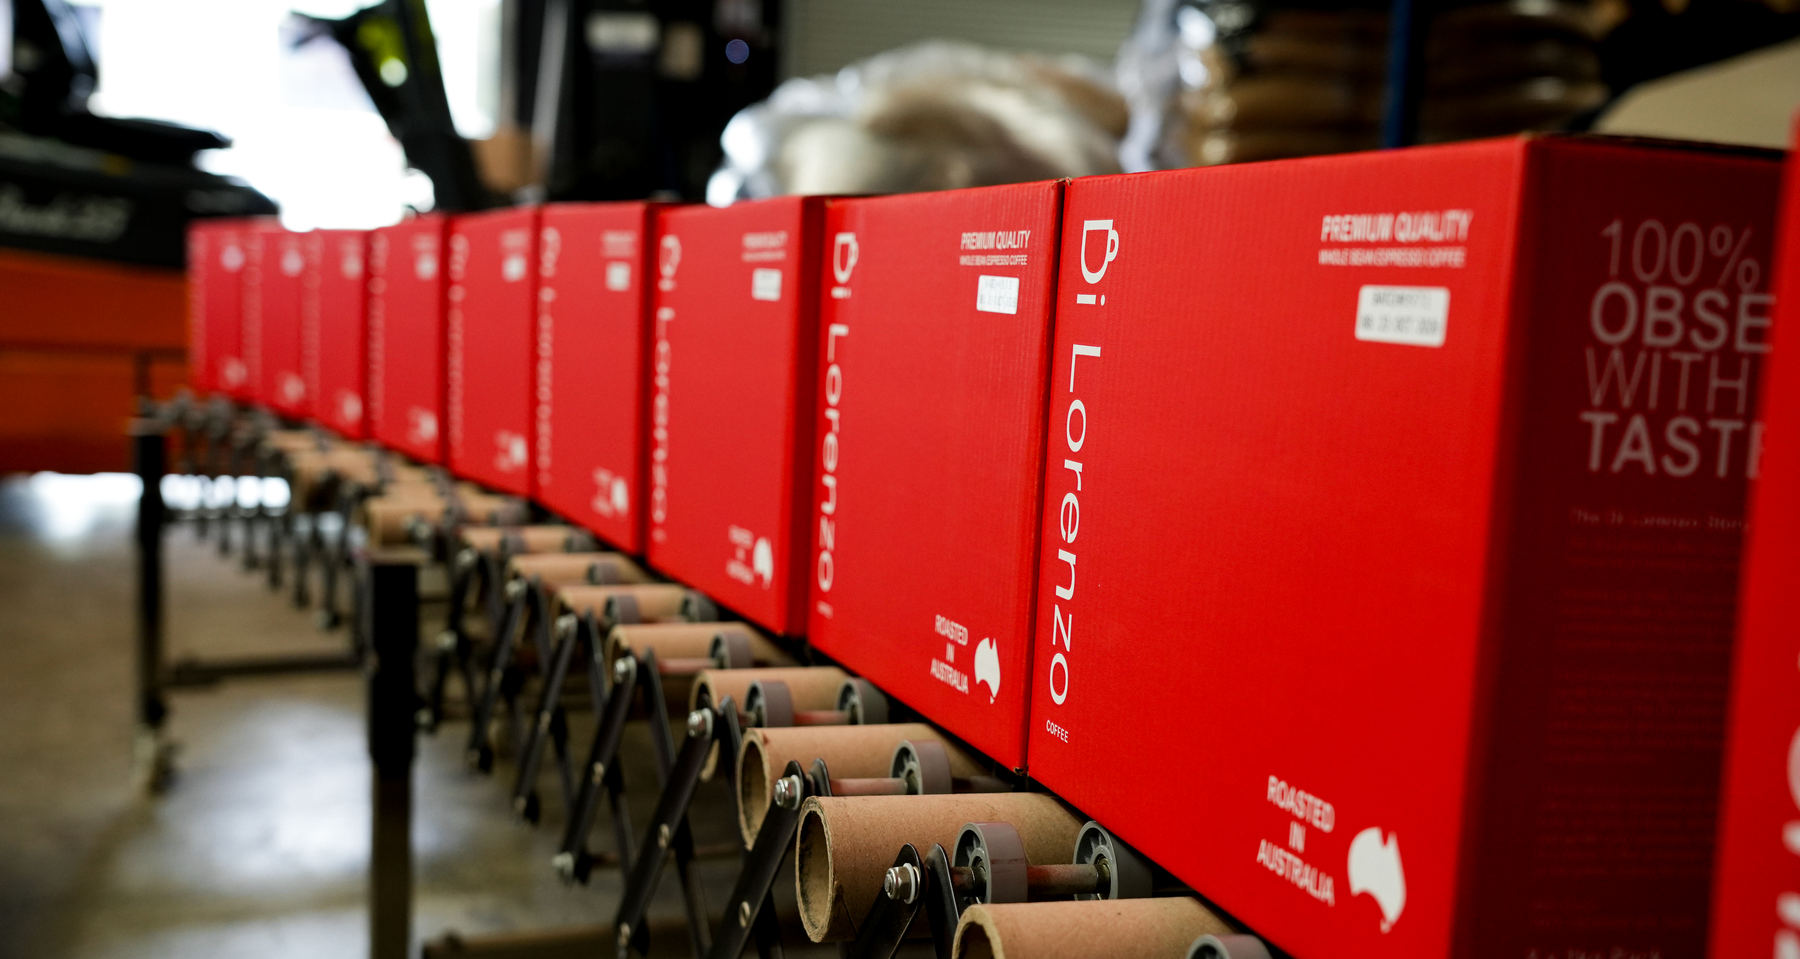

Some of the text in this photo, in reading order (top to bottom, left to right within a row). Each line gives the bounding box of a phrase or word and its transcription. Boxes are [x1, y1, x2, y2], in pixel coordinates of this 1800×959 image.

[996, 229, 1031, 249] QUALITY
[1321, 208, 1473, 243] PREMIUM QUALITY
[1600, 219, 1760, 292] 100%
[1586, 347, 1750, 415] WITH
[817, 323, 850, 593] Lorenzo
[1046, 218, 1119, 744] Di Lorenzo COFFEE
[935, 614, 968, 647] ROASTED
[946, 642, 955, 664] IN
[930, 658, 969, 695] AUSTRALIA
[1267, 774, 1335, 833] ROASTED
[1289, 821, 1306, 854] IN
[1256, 838, 1335, 907] AUSTRALIA
